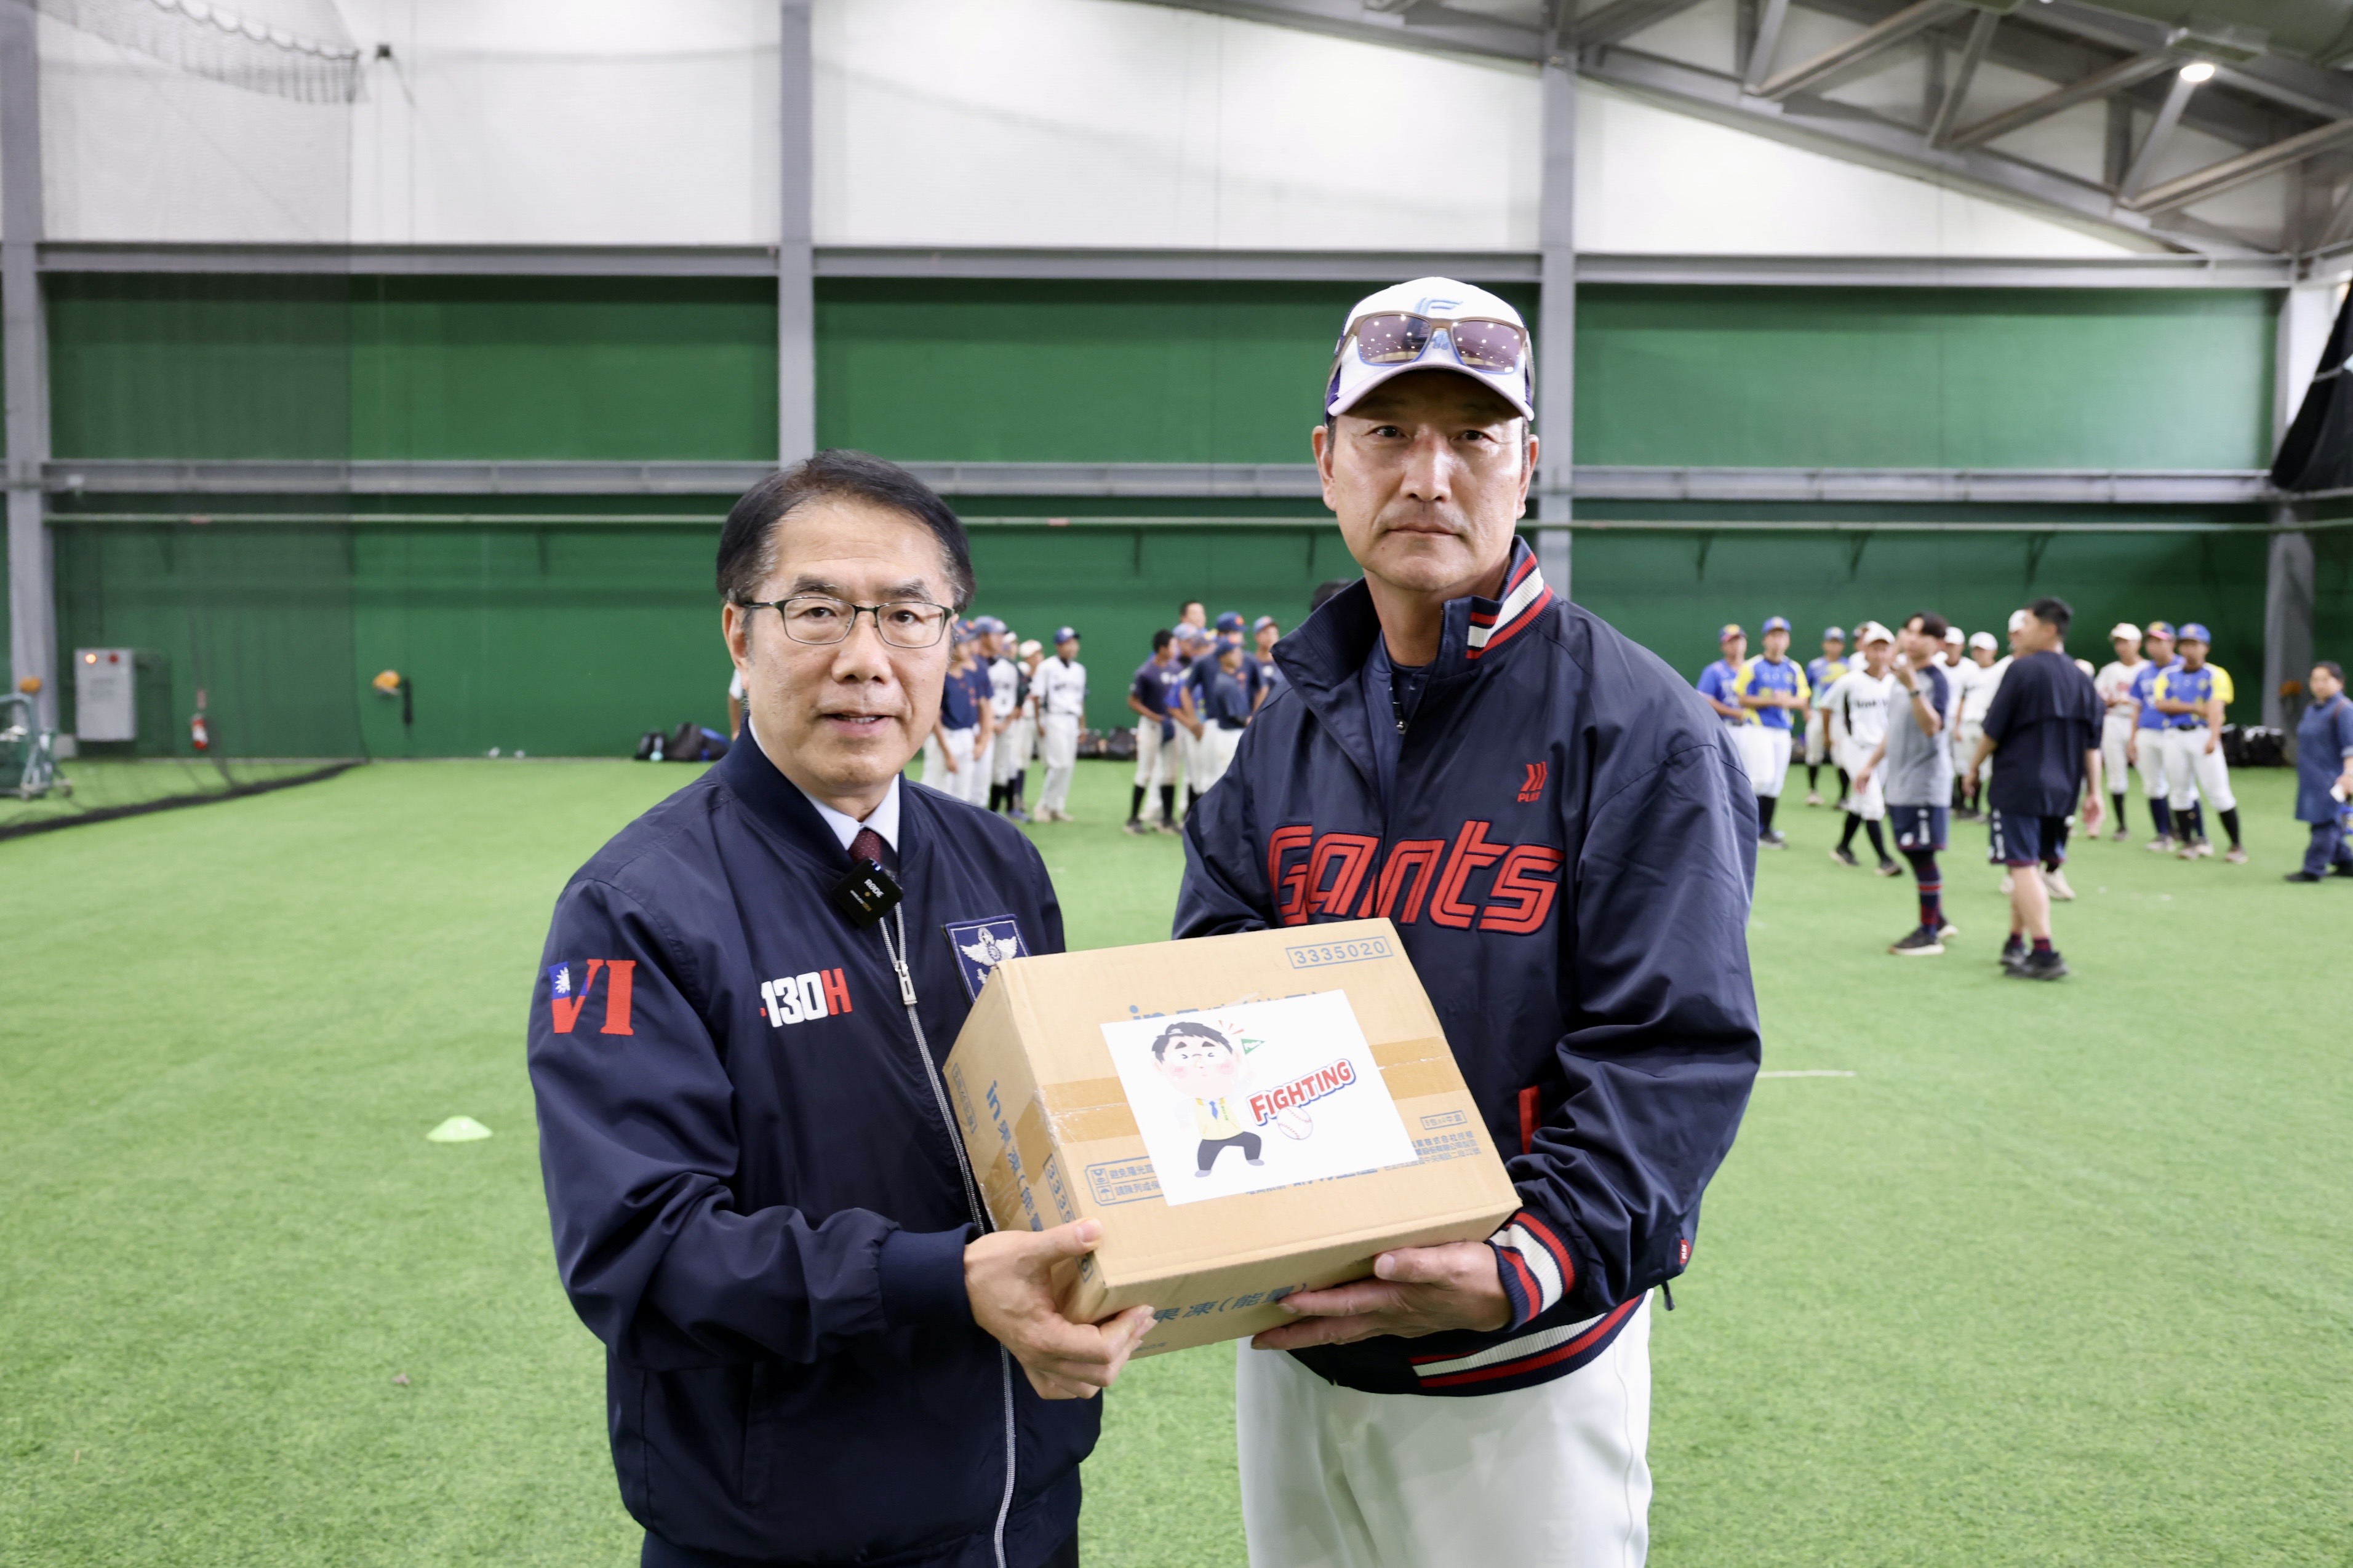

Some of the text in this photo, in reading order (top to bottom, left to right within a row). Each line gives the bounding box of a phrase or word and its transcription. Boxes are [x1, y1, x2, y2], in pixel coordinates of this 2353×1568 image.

[1295, 941, 1385, 964] 3335020
[547, 958, 637, 1036] VI
[1249, 1061, 1351, 1122] FIGHTING
[1048, 1164, 1089, 1273] 33350
